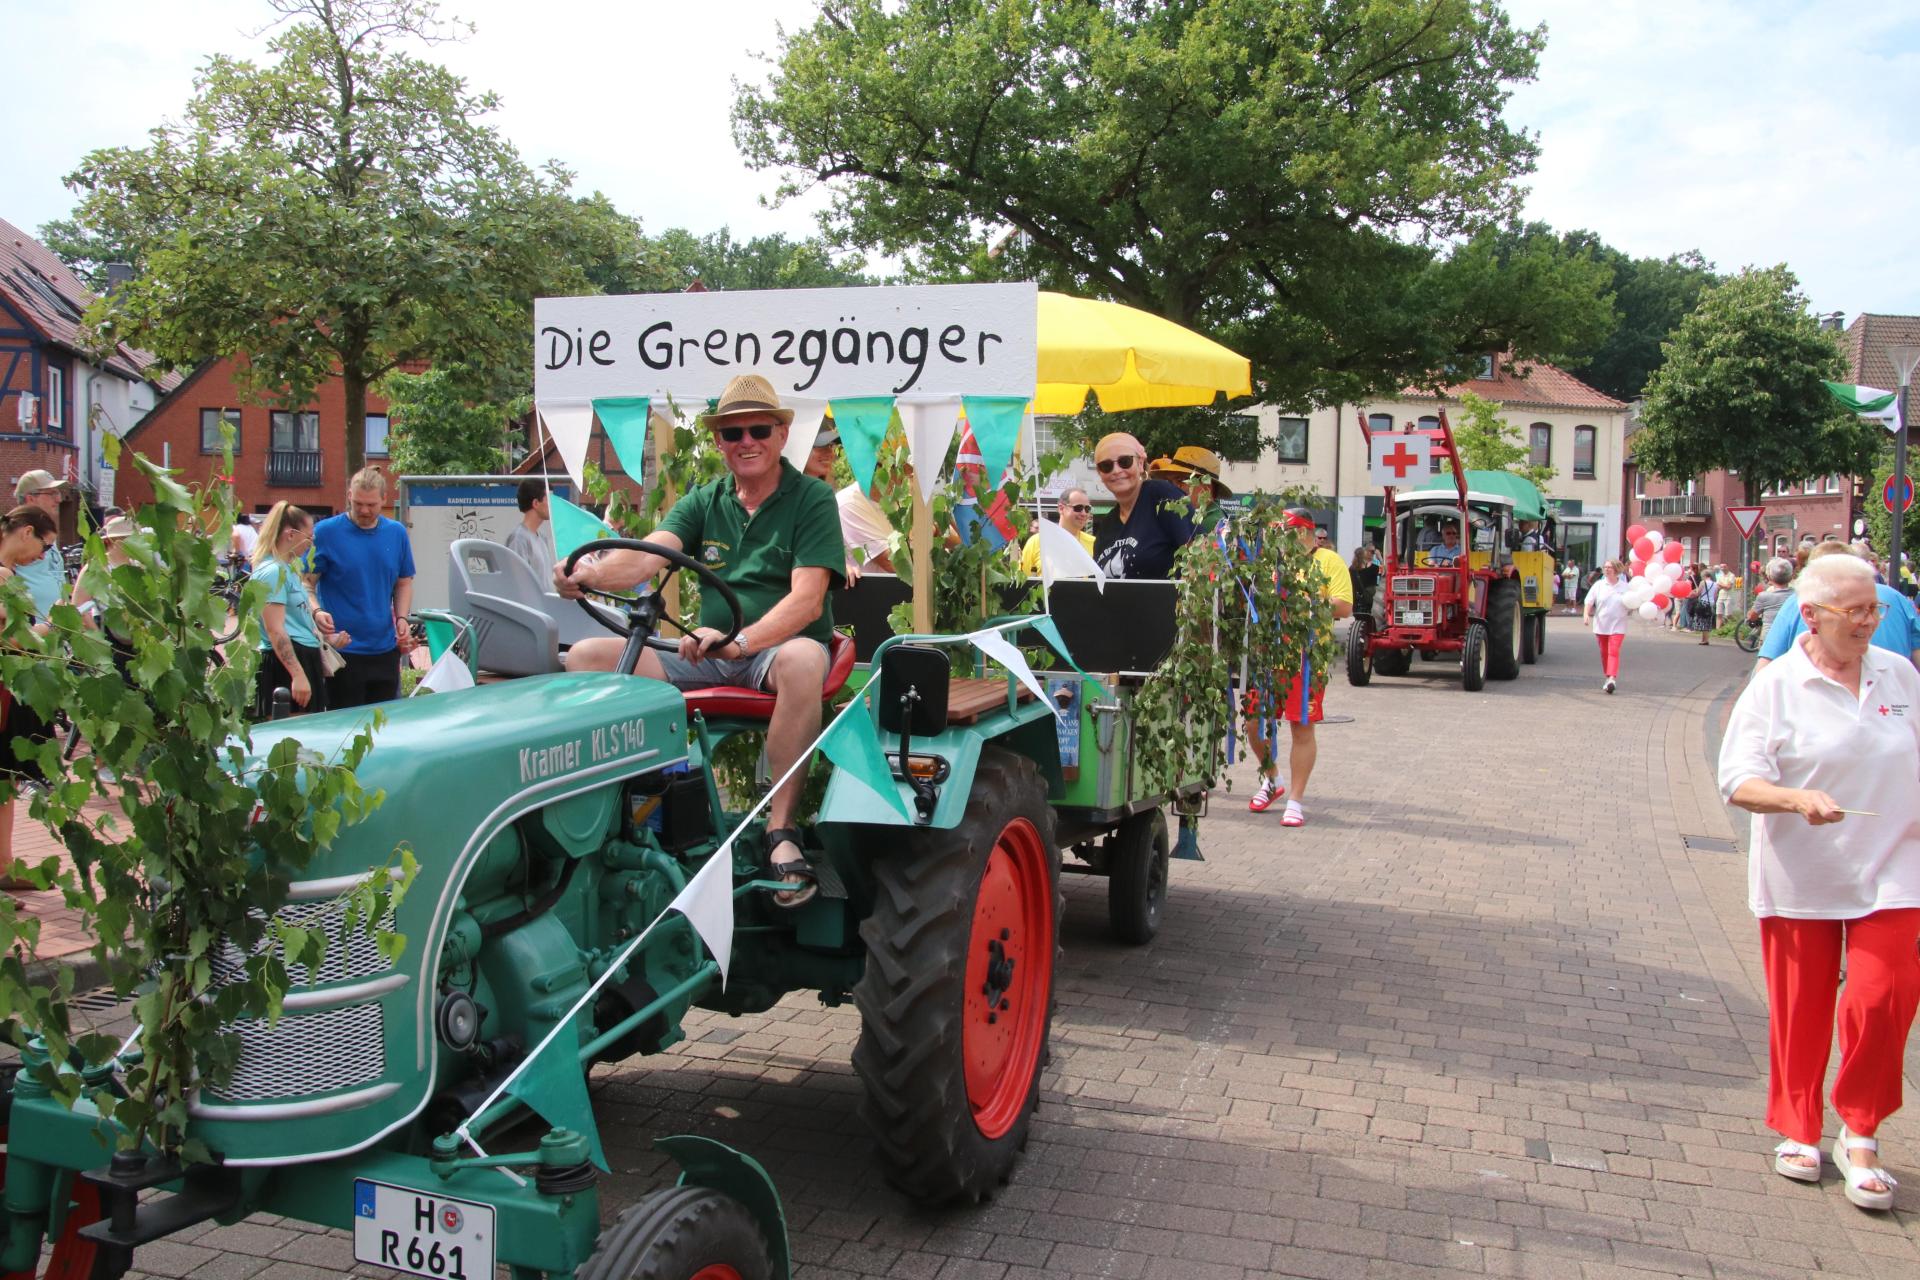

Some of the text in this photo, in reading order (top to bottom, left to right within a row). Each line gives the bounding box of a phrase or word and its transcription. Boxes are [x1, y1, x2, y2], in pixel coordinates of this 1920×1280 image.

[541, 316, 1003, 394] Die Grenzgänger
[491, 497, 519, 505] WUNSTOR
[519, 739, 582, 784] Kramer
[415, 1196, 435, 1234] H
